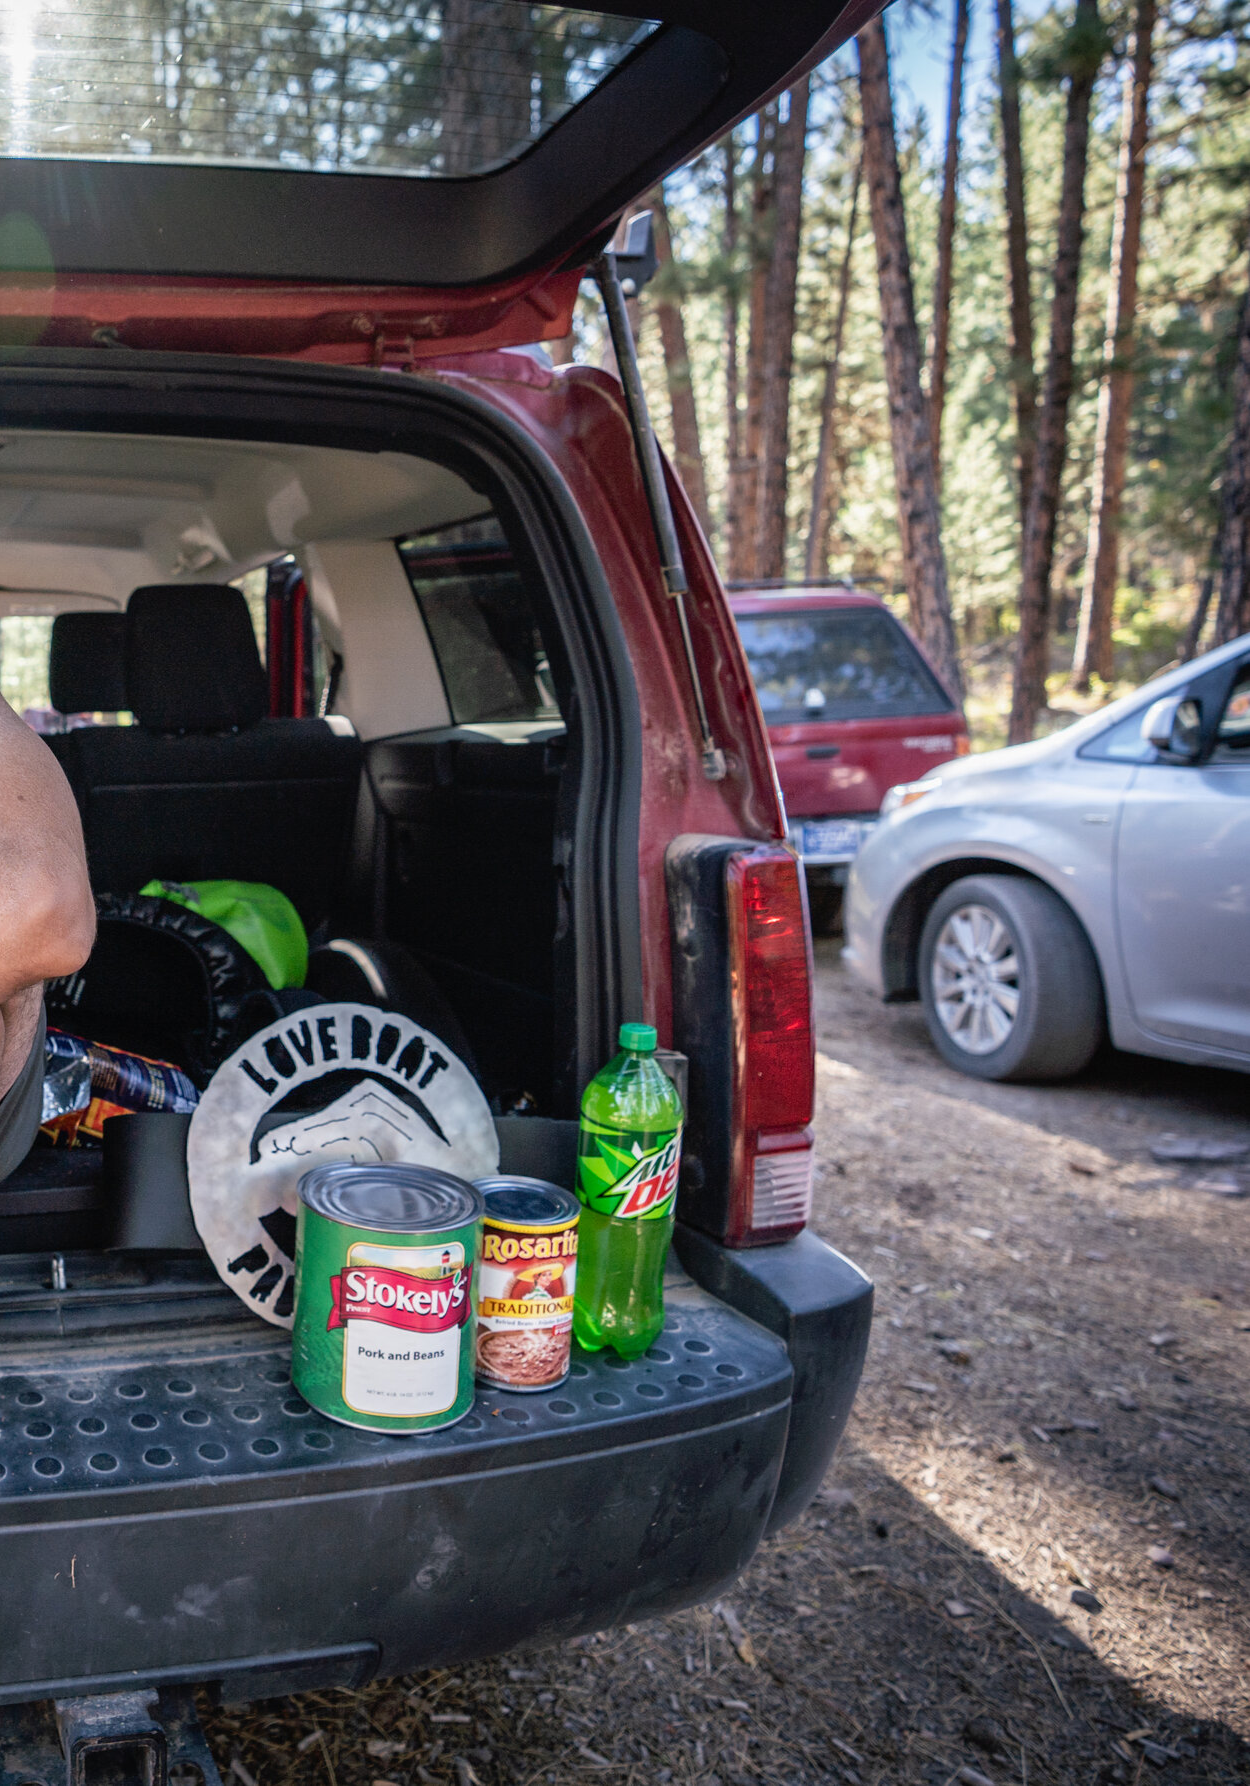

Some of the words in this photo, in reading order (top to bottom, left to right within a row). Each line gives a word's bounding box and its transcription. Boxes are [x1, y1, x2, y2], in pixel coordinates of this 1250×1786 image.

[238, 1016, 340, 1096] LOVE
[351, 1014, 449, 1089] BOAT
[346, 1269, 466, 1318] Stokely's
[358, 1346, 385, 1360] Pork
[388, 1350, 410, 1361] and
[413, 1348, 445, 1361] Beans
